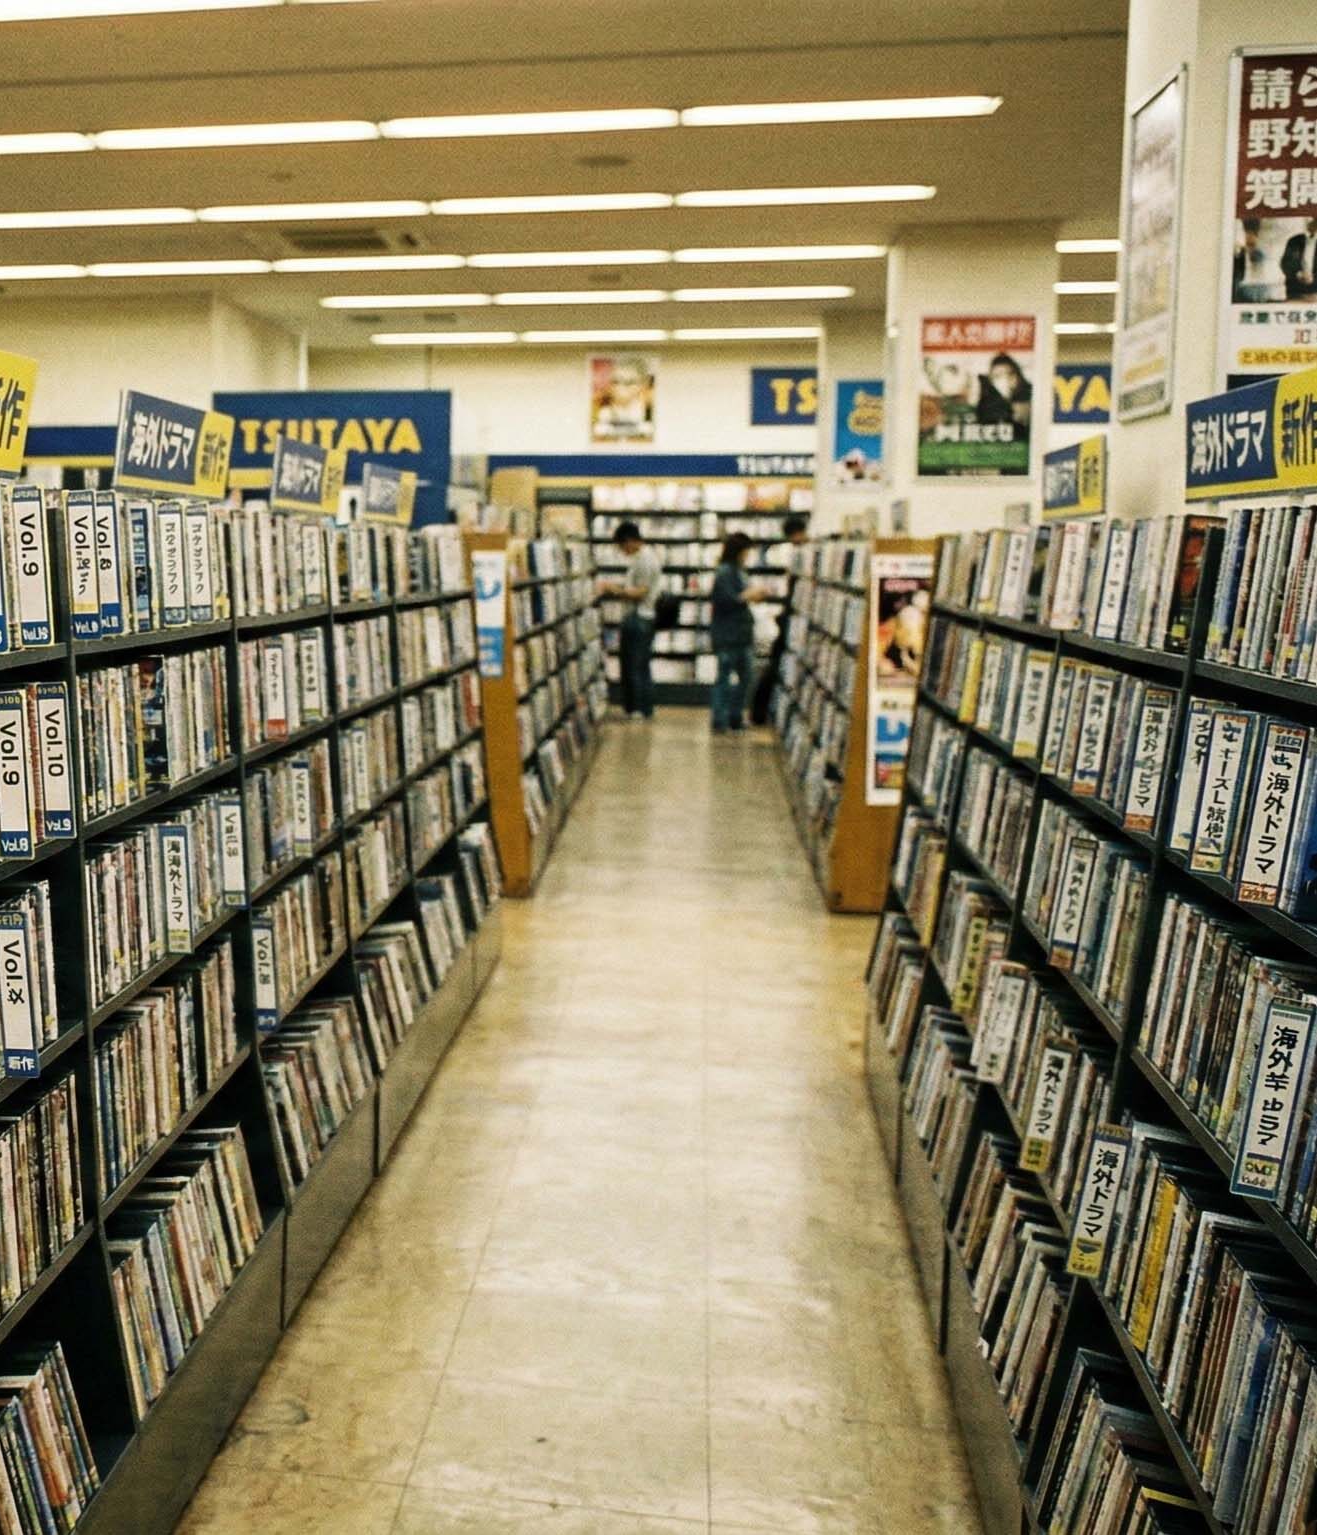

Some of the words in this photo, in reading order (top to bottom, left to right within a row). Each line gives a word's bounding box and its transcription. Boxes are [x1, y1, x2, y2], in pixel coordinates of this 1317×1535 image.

[127, 411, 196, 470] 海外ドラマ
[240, 418, 422, 454] TSUTAYA
[1191, 410, 1267, 475] 海外ドラマ
[19, 513, 39, 578] Vol.9
[0, 720, 20, 787] Vol.9
[44, 709, 65, 778] Vol.10
[1254, 772, 1292, 874] 海外ドラマ
